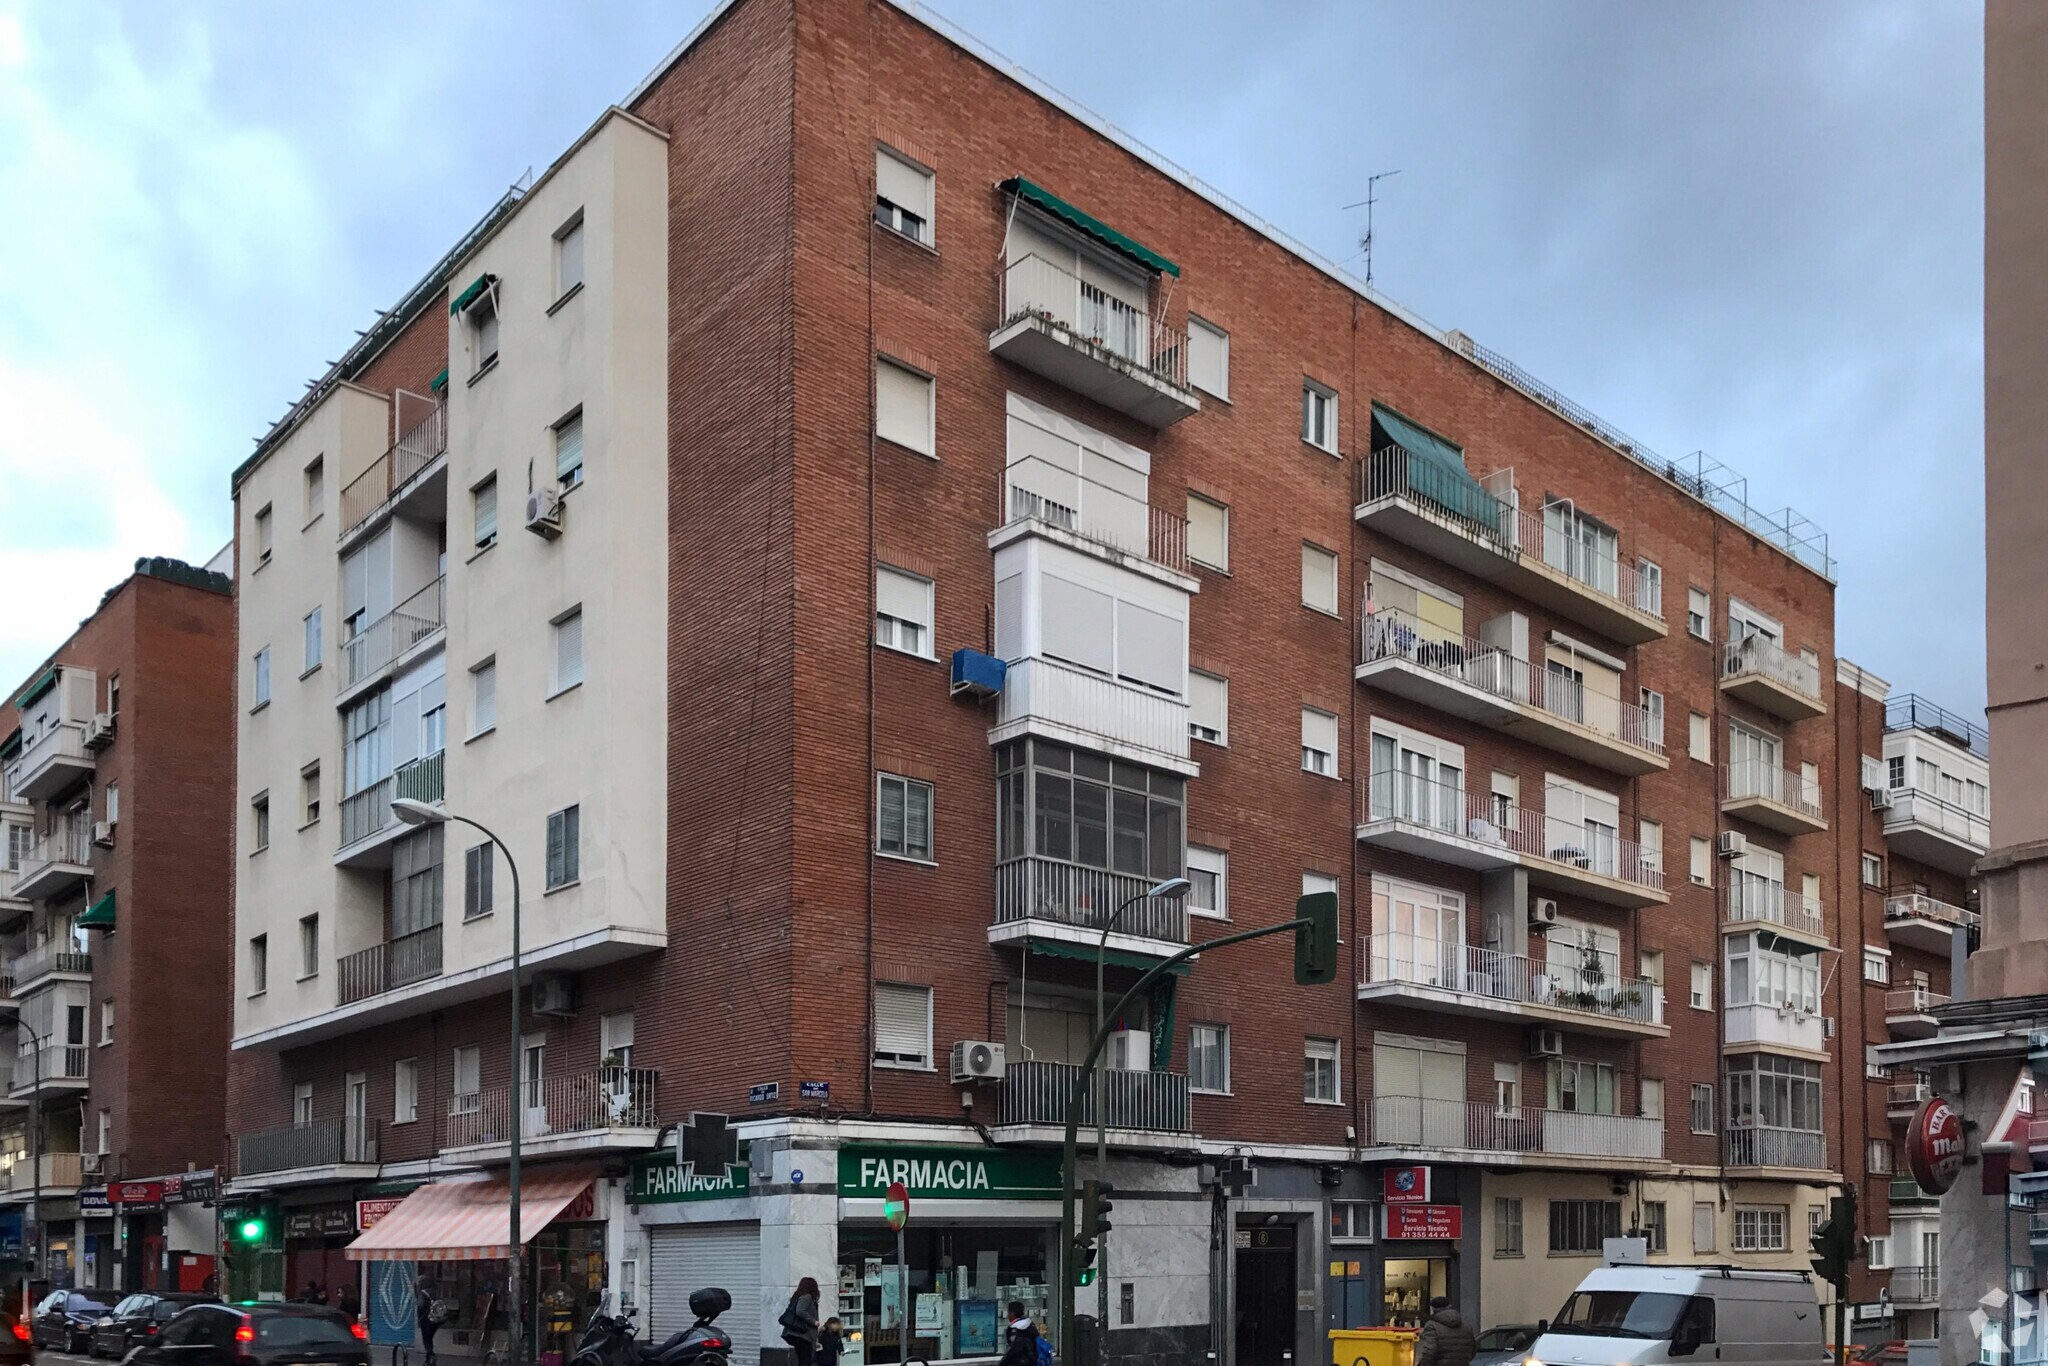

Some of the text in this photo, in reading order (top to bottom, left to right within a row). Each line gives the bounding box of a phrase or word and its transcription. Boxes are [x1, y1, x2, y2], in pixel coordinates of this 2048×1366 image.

[1932, 1109, 1948, 1131] BAR
[860, 1158, 989, 1190] FARMACIA
[83, 1196, 109, 1206] BBVA
[363, 1202, 399, 1213] ALIMENTAC
